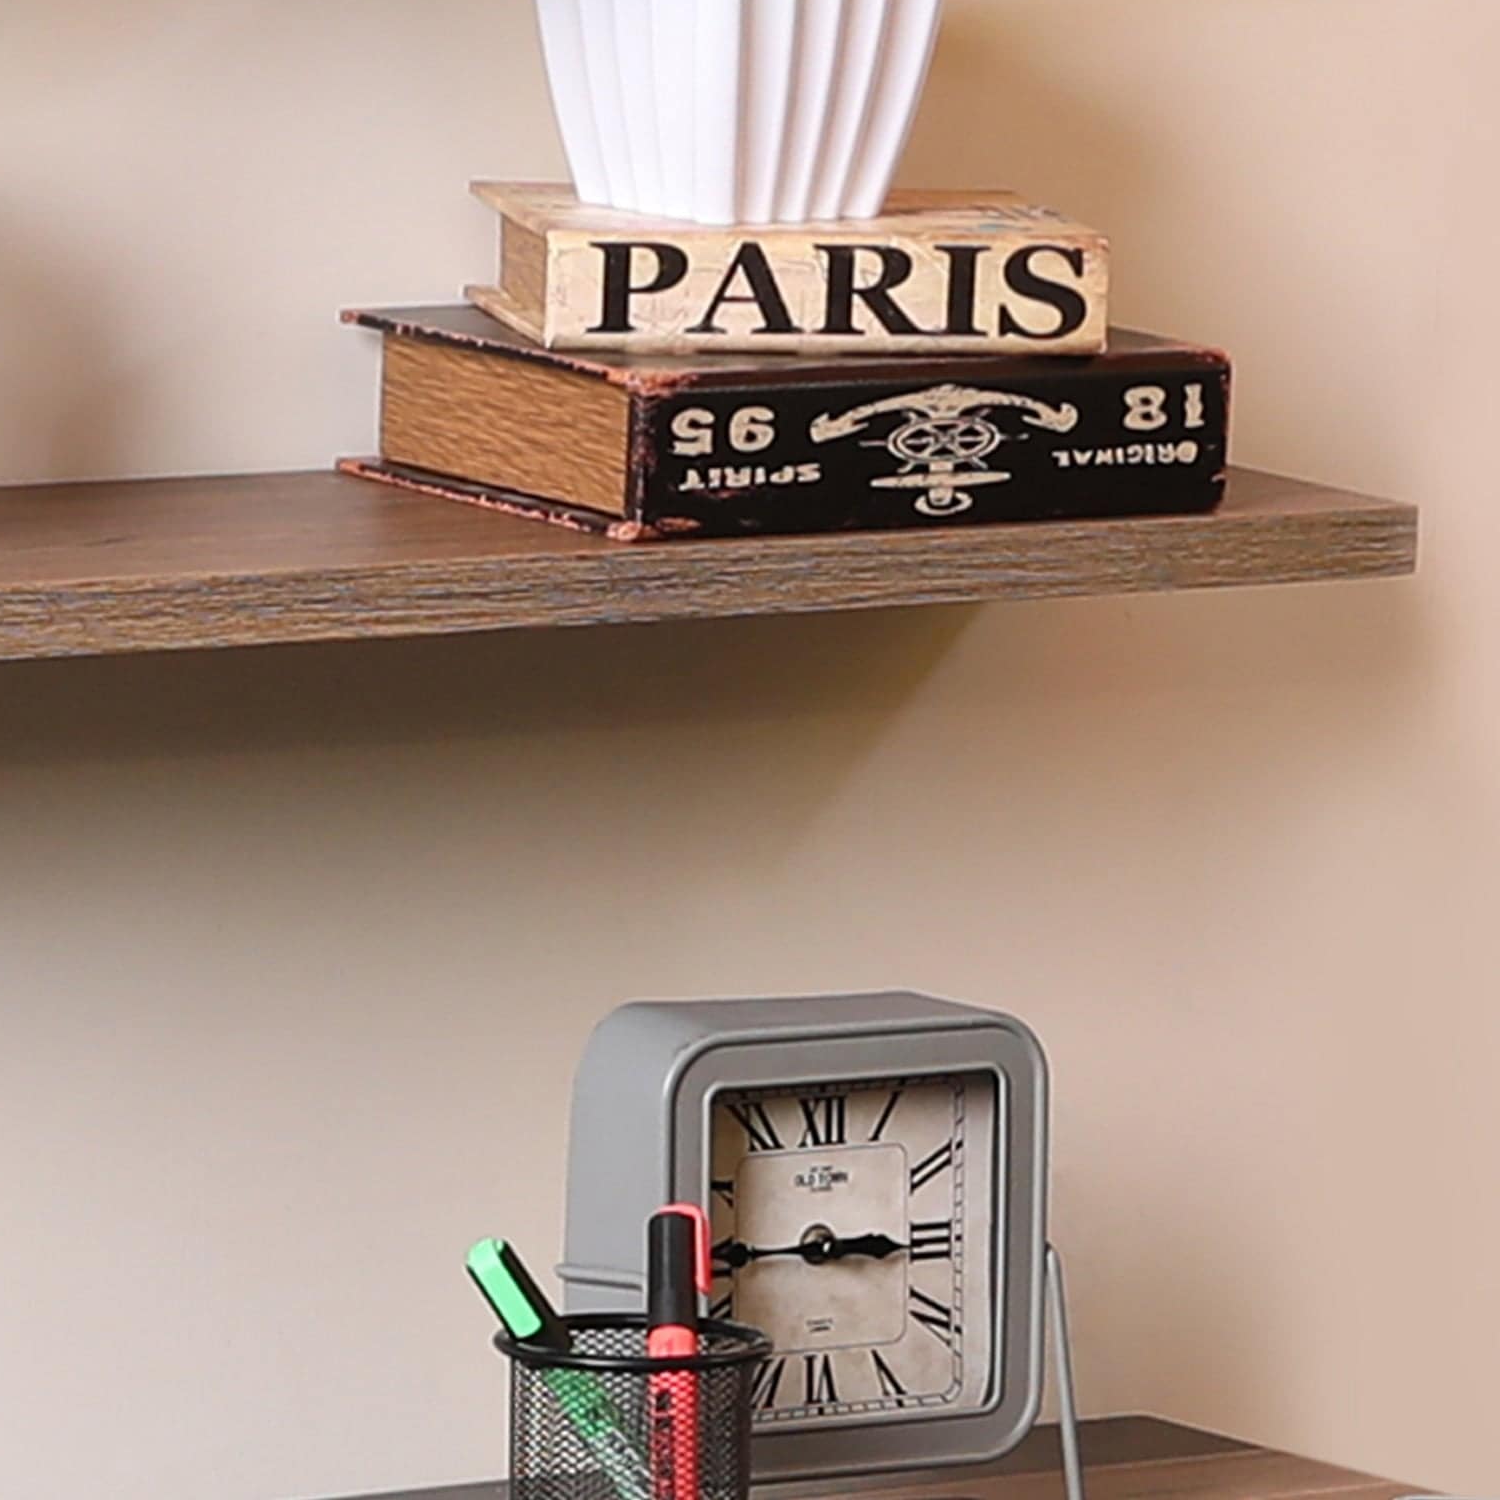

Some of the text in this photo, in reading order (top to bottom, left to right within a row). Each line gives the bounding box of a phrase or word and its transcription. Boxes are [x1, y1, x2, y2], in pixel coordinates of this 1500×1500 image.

[585, 240, 1088, 340] PARIS
[1123, 382, 1205, 431] 18
[671, 406, 775, 457] 95
[1052, 440, 1199, 468] ORIGINAL
[678, 463, 821, 492] SPIRIT
